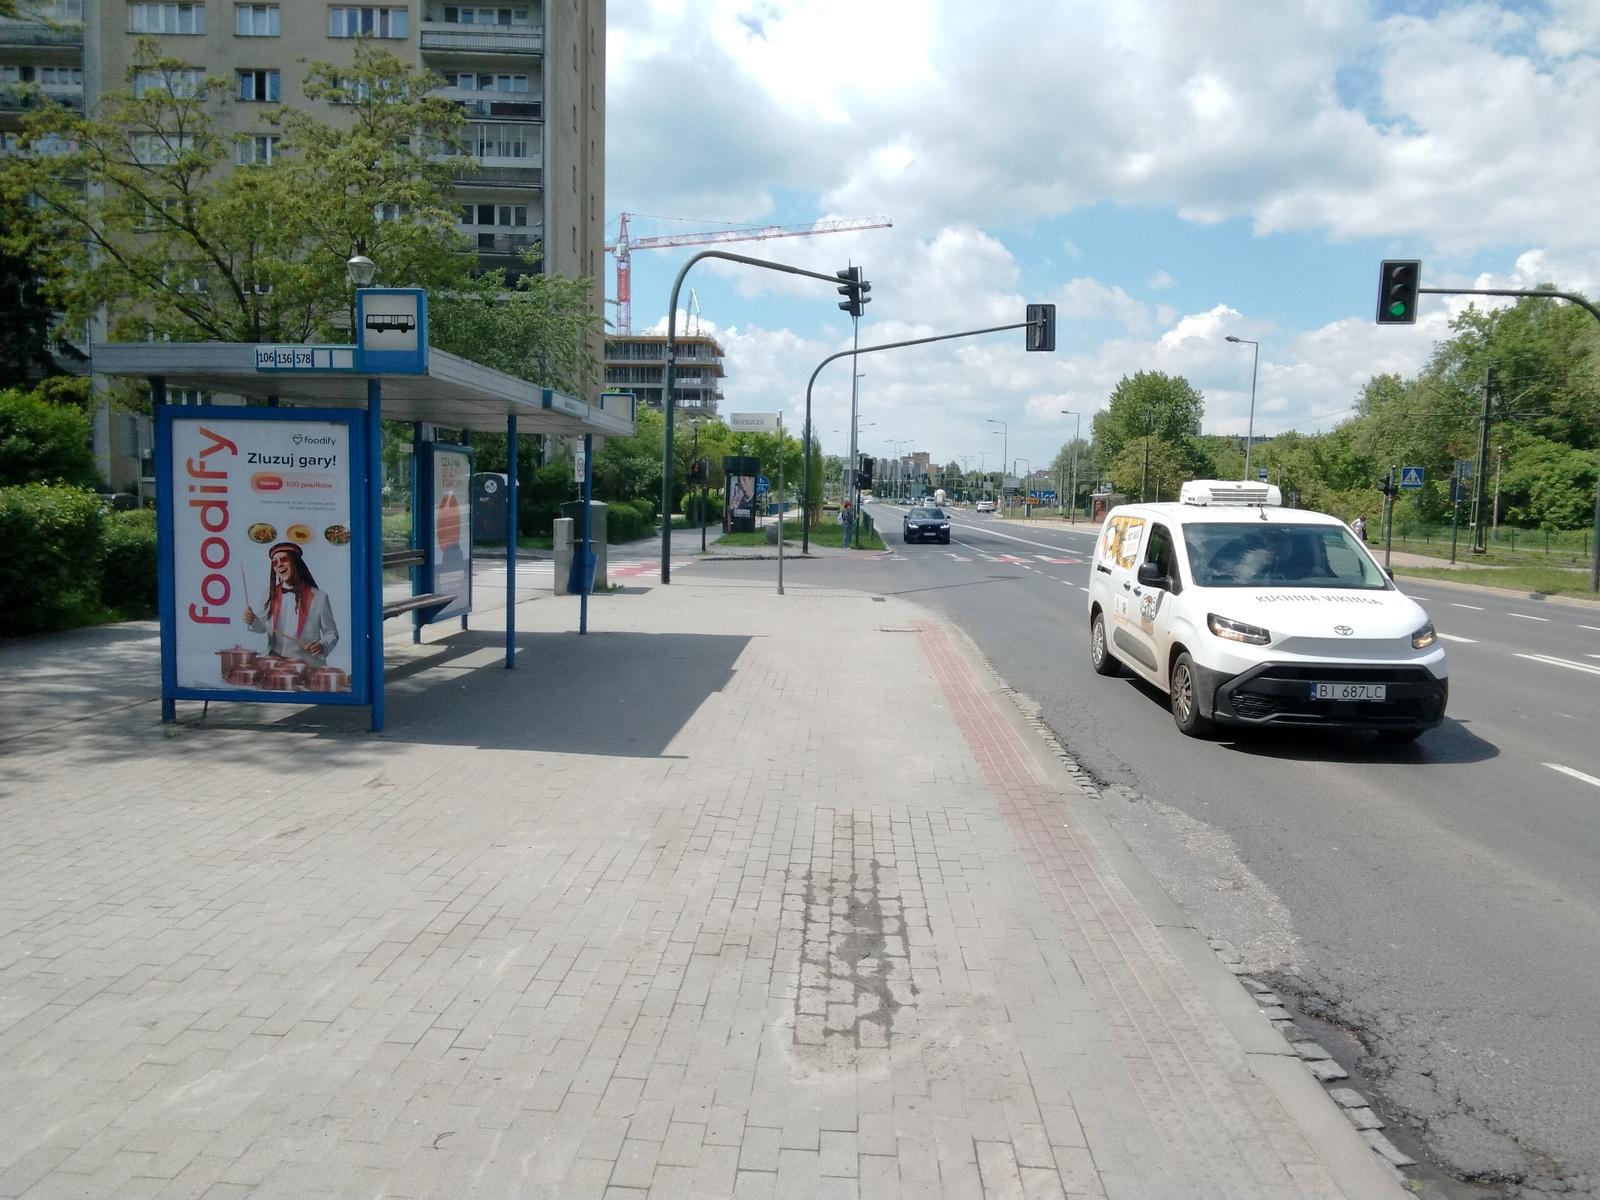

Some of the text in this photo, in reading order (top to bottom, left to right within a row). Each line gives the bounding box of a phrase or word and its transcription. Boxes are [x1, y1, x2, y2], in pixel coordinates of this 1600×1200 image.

[259, 352, 274, 363] 106
[278, 353, 292, 364] 136
[296, 353, 311, 364] 578
[304, 435, 336, 446] foodify
[247, 452, 336, 468] Zluzuj gary!
[186, 426, 238, 625] foodify
[1319, 685, 1383, 699] BI 687LC
